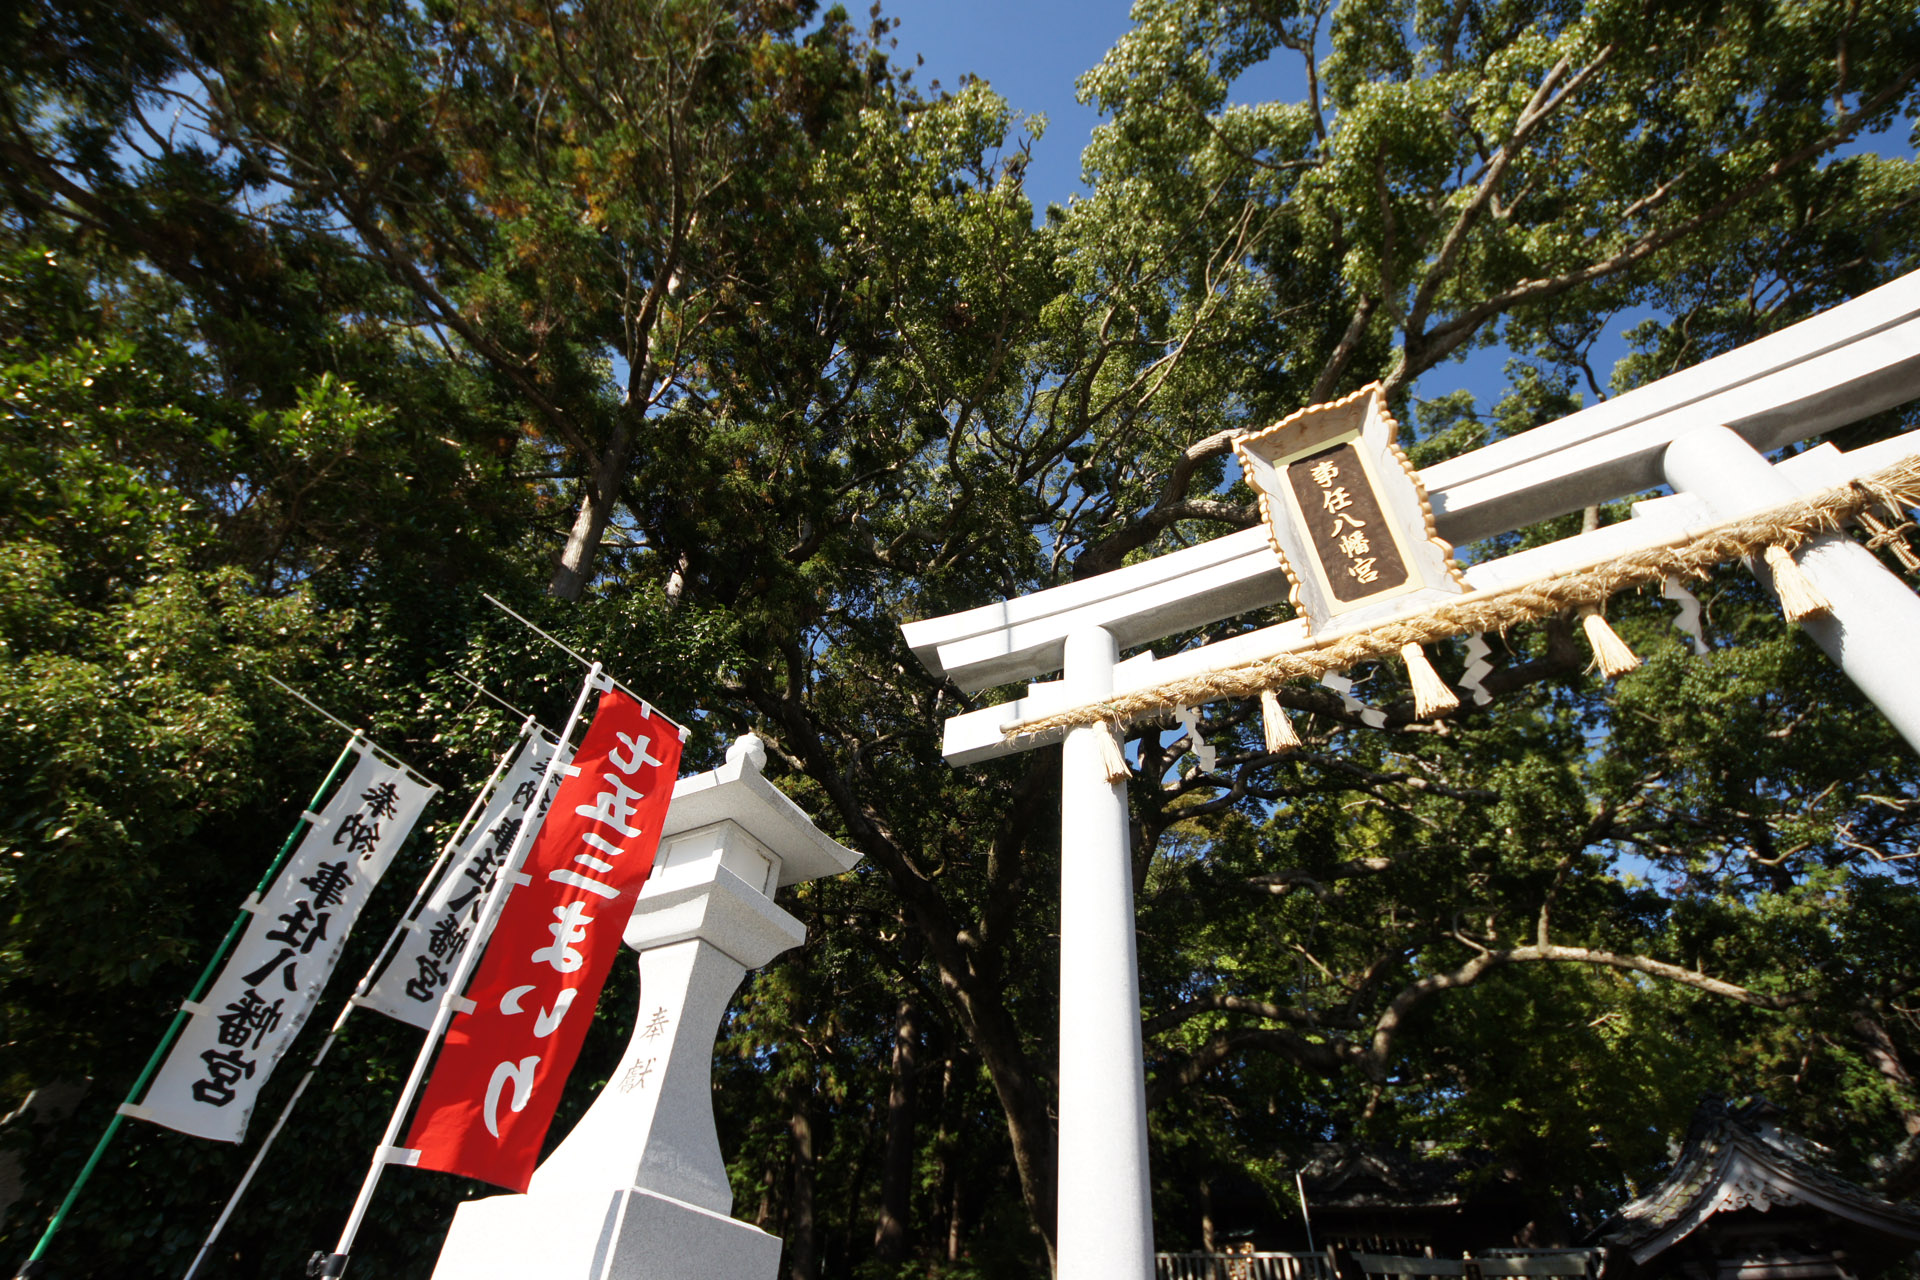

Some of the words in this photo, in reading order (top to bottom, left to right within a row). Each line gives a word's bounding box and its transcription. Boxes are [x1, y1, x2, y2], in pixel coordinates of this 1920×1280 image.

[1310, 460, 1379, 584] 事任八幡宮
